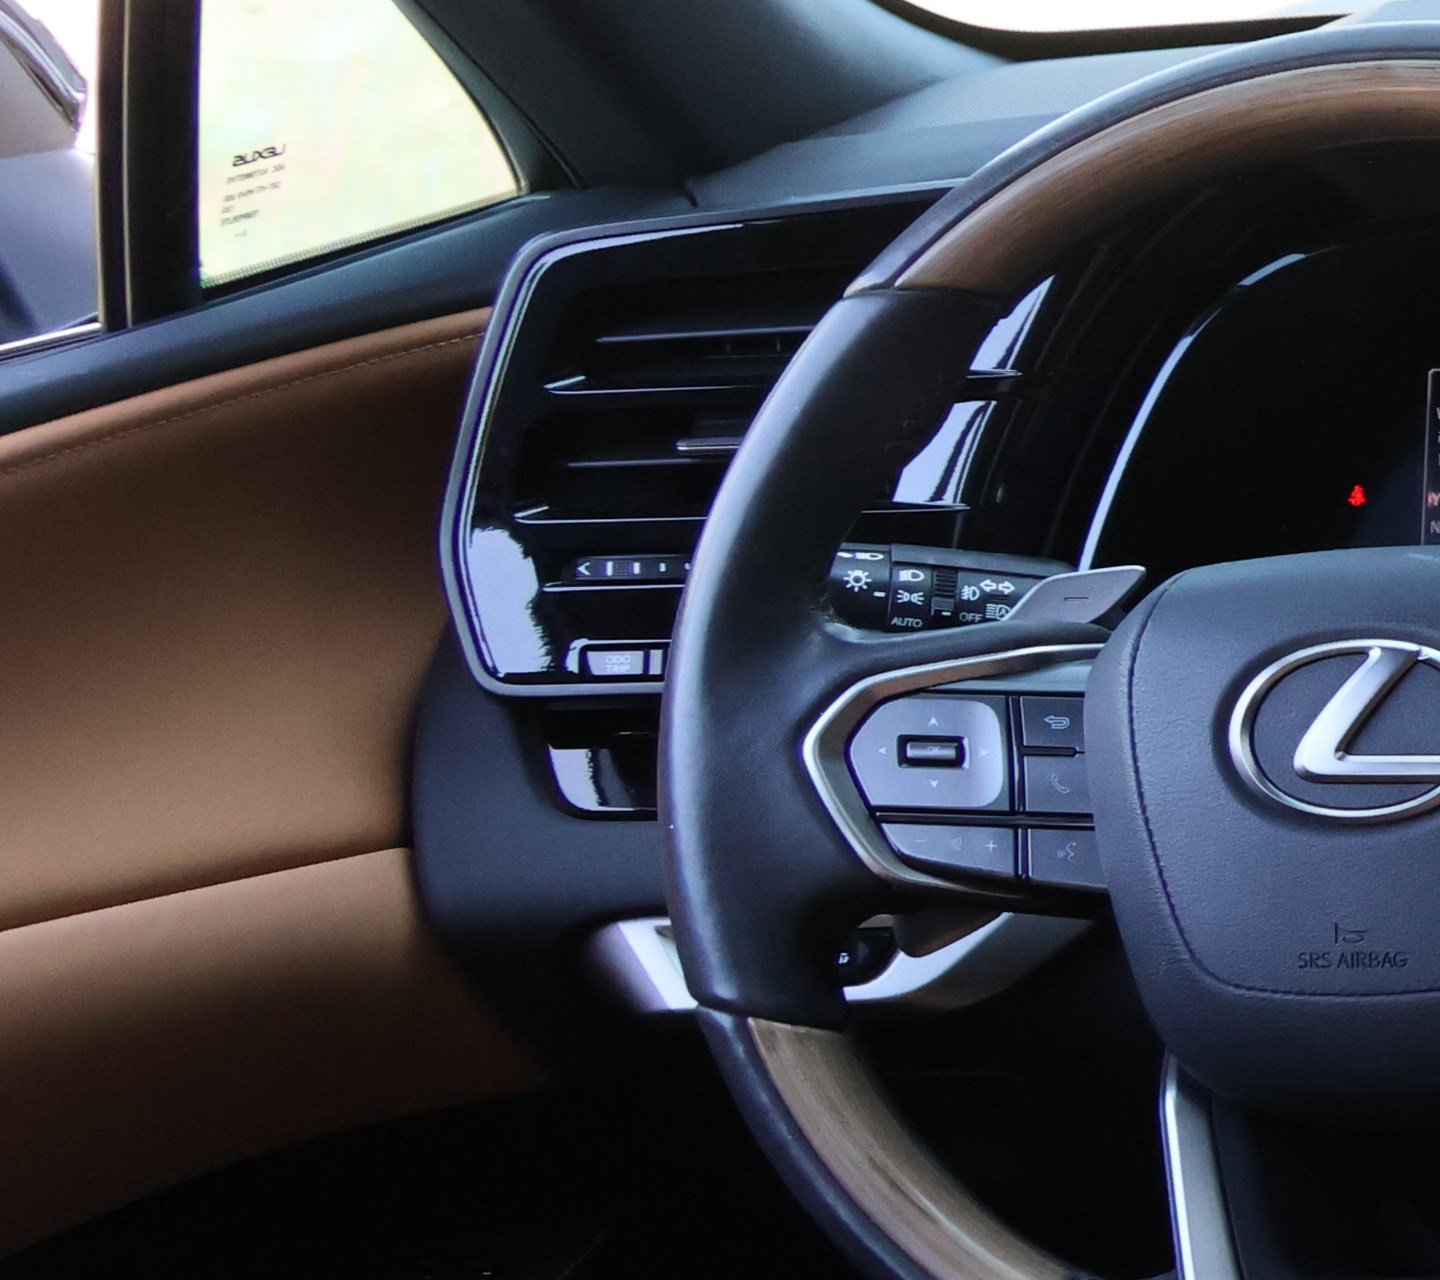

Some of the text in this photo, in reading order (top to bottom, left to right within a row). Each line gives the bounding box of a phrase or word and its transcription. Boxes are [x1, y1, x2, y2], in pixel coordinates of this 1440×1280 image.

[890, 616, 924, 628] AUTO
[958, 611, 983, 623] OFF
[1297, 951, 1410, 969] SRS AIRBAG
